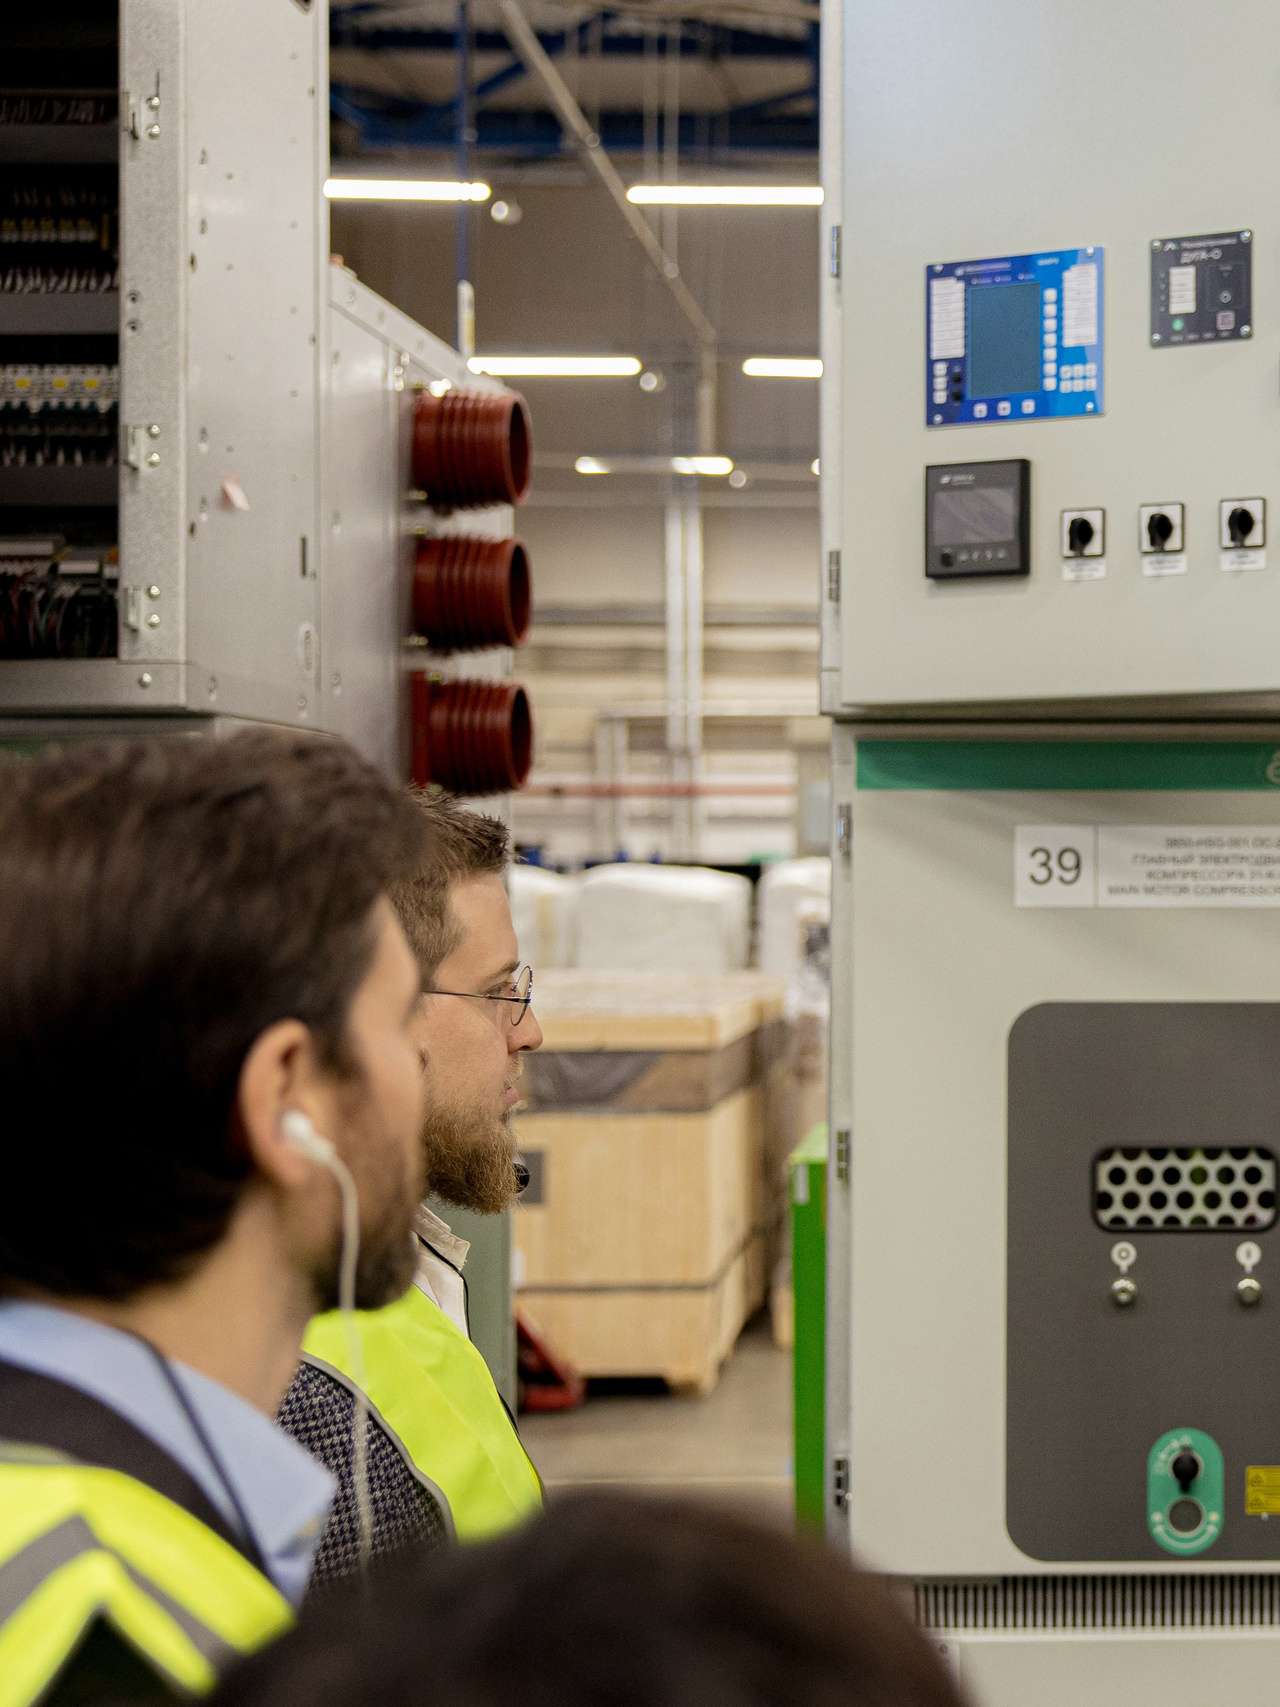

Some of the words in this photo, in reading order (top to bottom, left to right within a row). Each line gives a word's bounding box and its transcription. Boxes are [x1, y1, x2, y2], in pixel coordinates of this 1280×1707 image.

[1028, 847, 1082, 885] 39
[1107, 885, 1139, 896] MAIN
[1143, 885, 1190, 896] MOTOR
